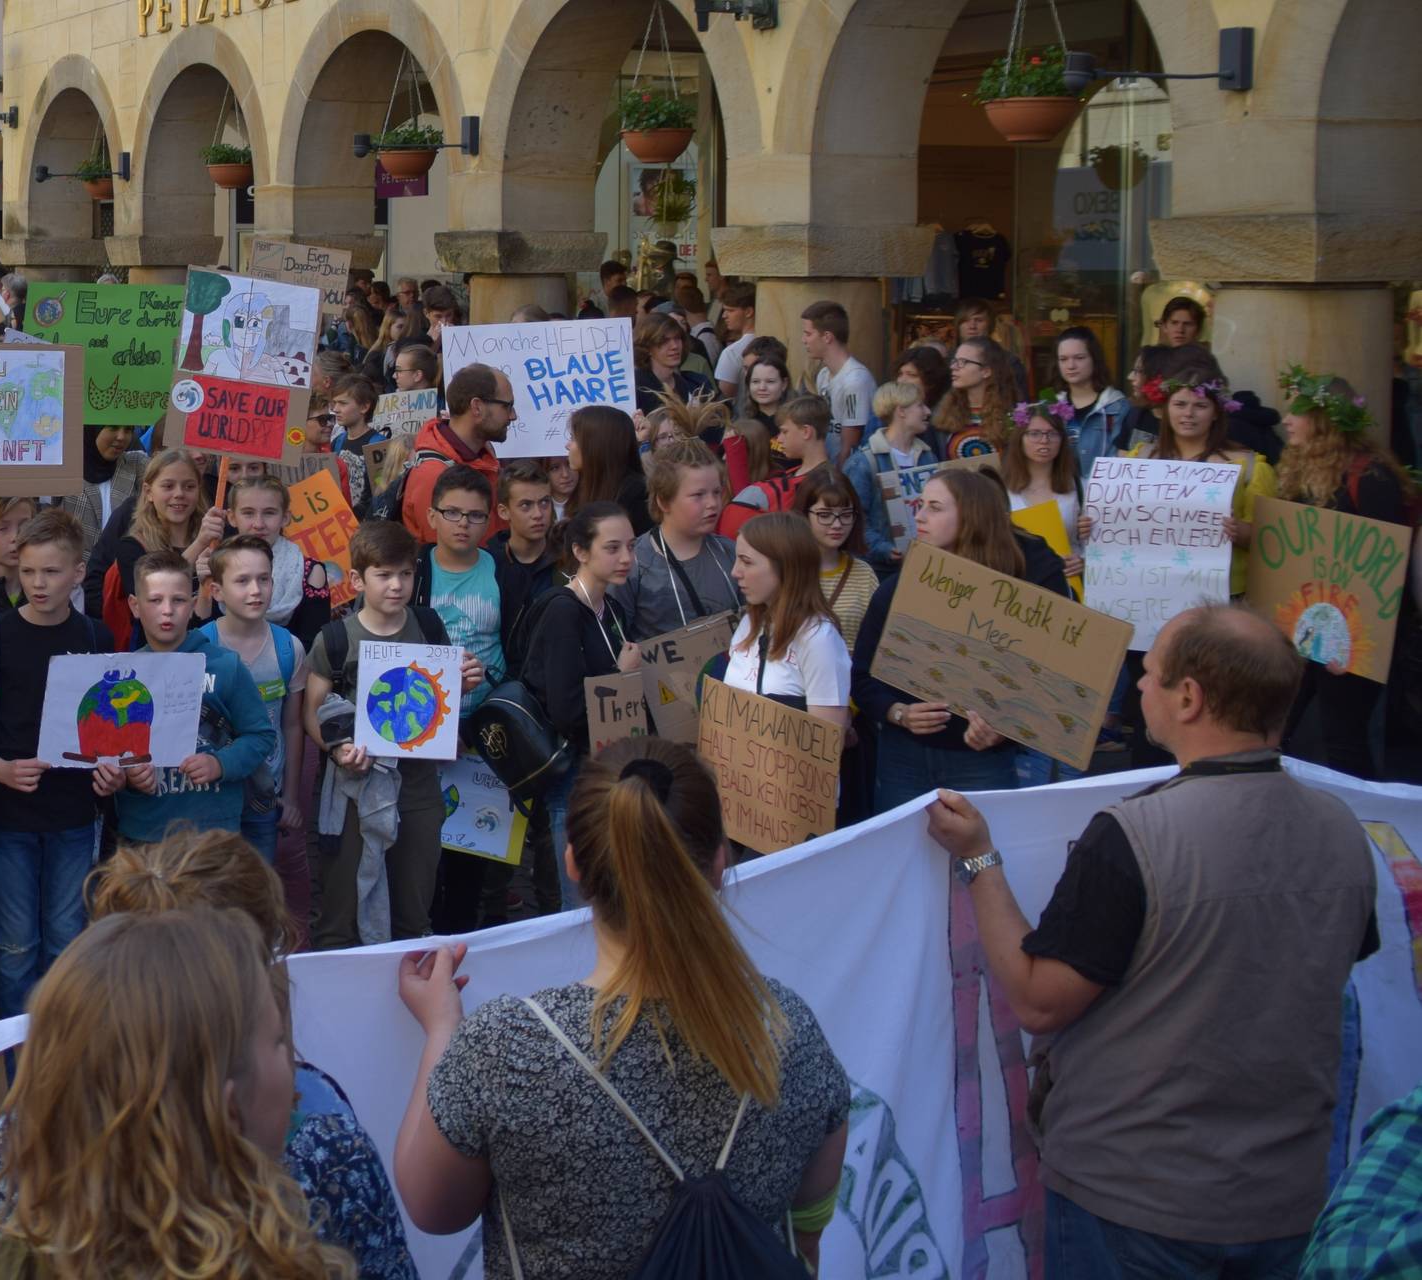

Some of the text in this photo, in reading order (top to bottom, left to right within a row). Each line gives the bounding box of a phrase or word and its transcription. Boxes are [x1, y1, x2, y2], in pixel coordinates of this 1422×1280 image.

[308, 247, 330, 265] Even
[75, 290, 132, 325] Eure
[447, 324, 631, 359] Manche HELDEN
[523, 350, 626, 381] BLAUE
[207, 386, 286, 418] SAVE OUR
[408, 390, 438, 411] WIND
[526, 375, 631, 412] HAARE
[386, 410, 414, 423] STATT
[1092, 461, 1241, 484] EURE KINDER
[303, 490, 329, 514] is
[1086, 482, 1198, 503] DURFTEN
[1087, 504, 1224, 526] DEN SCHNEE
[1086, 527, 1141, 546] NOCH
[1086, 565, 1226, 590] WAS IST MIT
[1257, 507, 1405, 620] OUR WORLD
[1313, 556, 1354, 589] IS ON
[918, 555, 1088, 648] Weniger Plastik ist
[966, 609, 1023, 649] Meer
[364, 644, 458, 661] HEUTE 2099
[640, 639, 685, 665] WE
[593, 684, 648, 724] There
[698, 725, 737, 763] HALT
[720, 762, 827, 827] BALD KEIN OBST
[736, 800, 752, 834] IM
